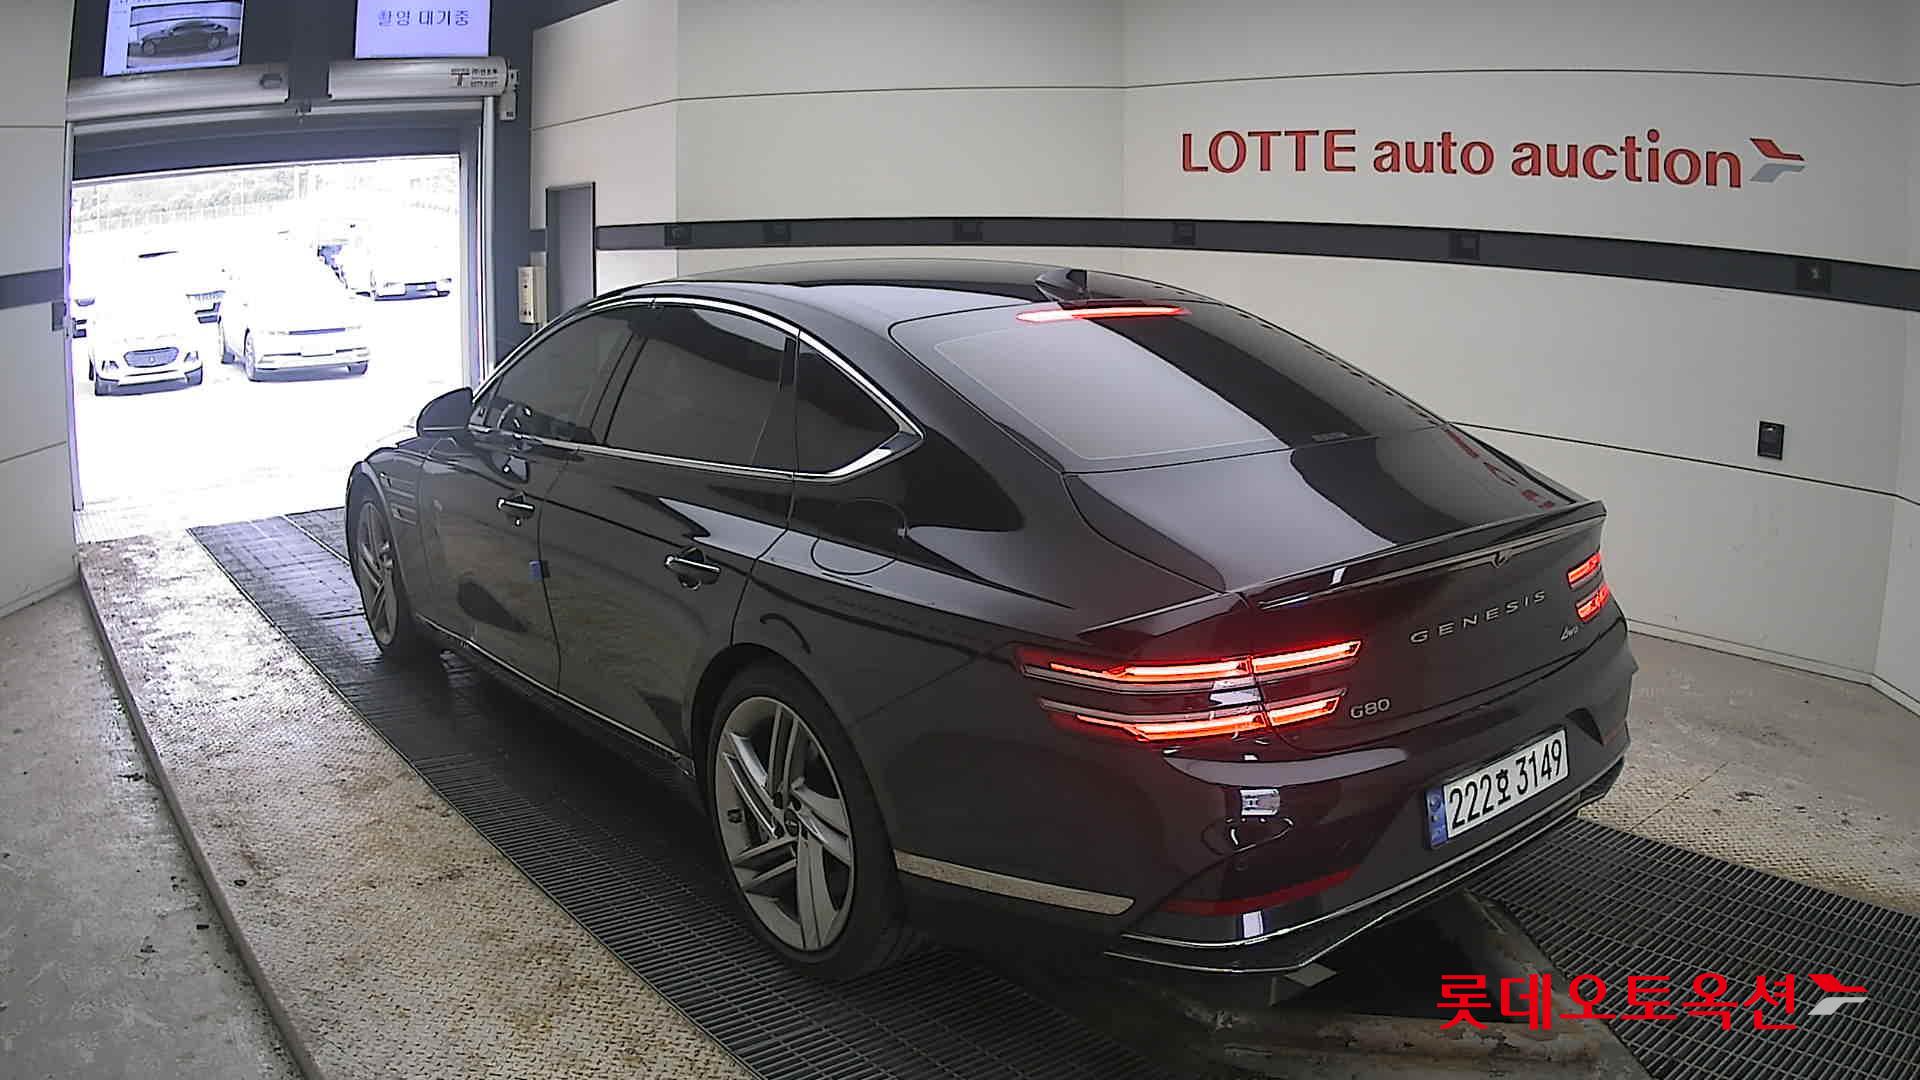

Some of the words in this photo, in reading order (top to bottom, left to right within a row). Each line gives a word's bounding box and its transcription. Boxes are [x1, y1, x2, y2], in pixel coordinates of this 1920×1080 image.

[418, 9, 469, 26] 대기중
[1181, 129, 1356, 173] LOTTE
[1372, 131, 1495, 176] auto
[1510, 128, 1742, 188] auction
[1410, 590, 1546, 644] GENESIS
[1350, 698, 1391, 720] G80
[1449, 768, 1512, 830] 222호
[1516, 739, 1562, 796] 3149
